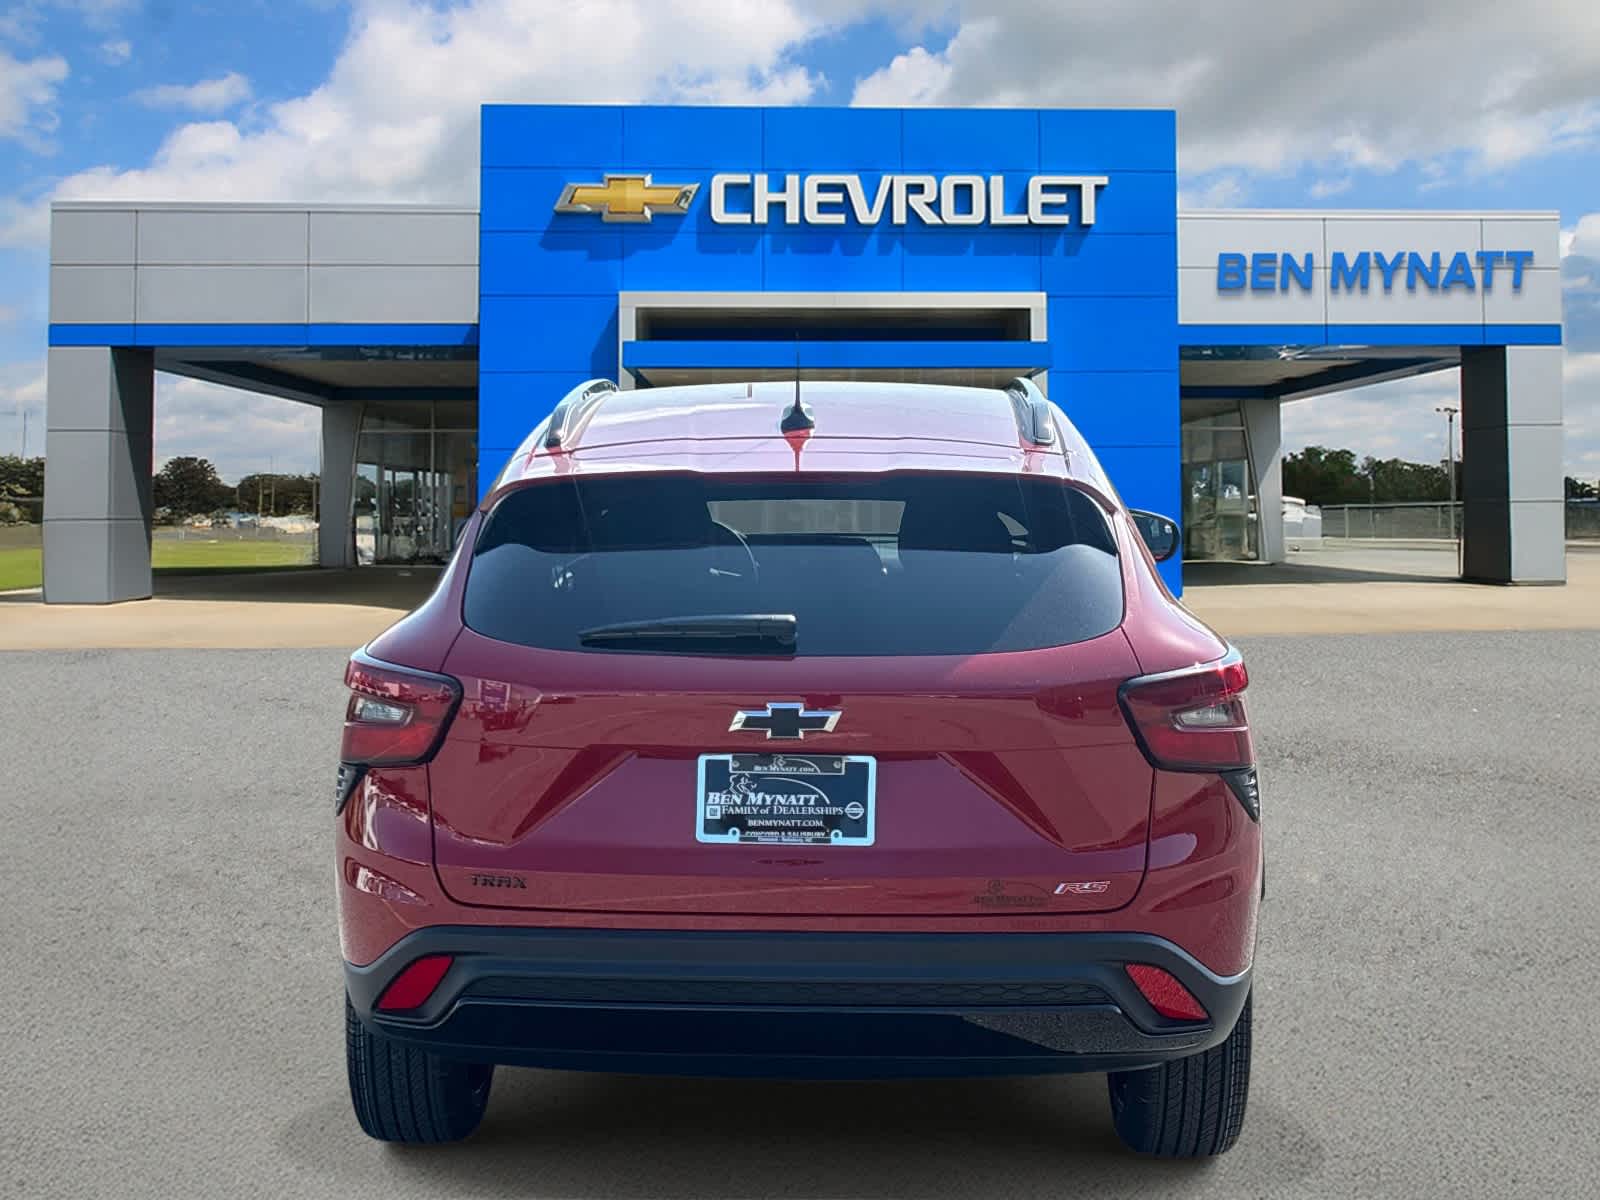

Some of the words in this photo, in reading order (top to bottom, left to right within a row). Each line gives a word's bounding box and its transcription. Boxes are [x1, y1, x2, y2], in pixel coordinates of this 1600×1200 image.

[710, 173, 1109, 225] CHEVROLET
[1217, 252, 1313, 291] BEN
[1330, 250, 1534, 291] MYNATT
[707, 791, 743, 805] BEN
[746, 792, 818, 806] MYNATT
[722, 805, 759, 815] FAMILY
[760, 806, 771, 815] of
[773, 805, 844, 816] DEALERSHIPS
[747, 819, 824, 828] BENMYNATT.COM
[471, 873, 528, 889] TRAX
[1053, 880, 1111, 895] RS
